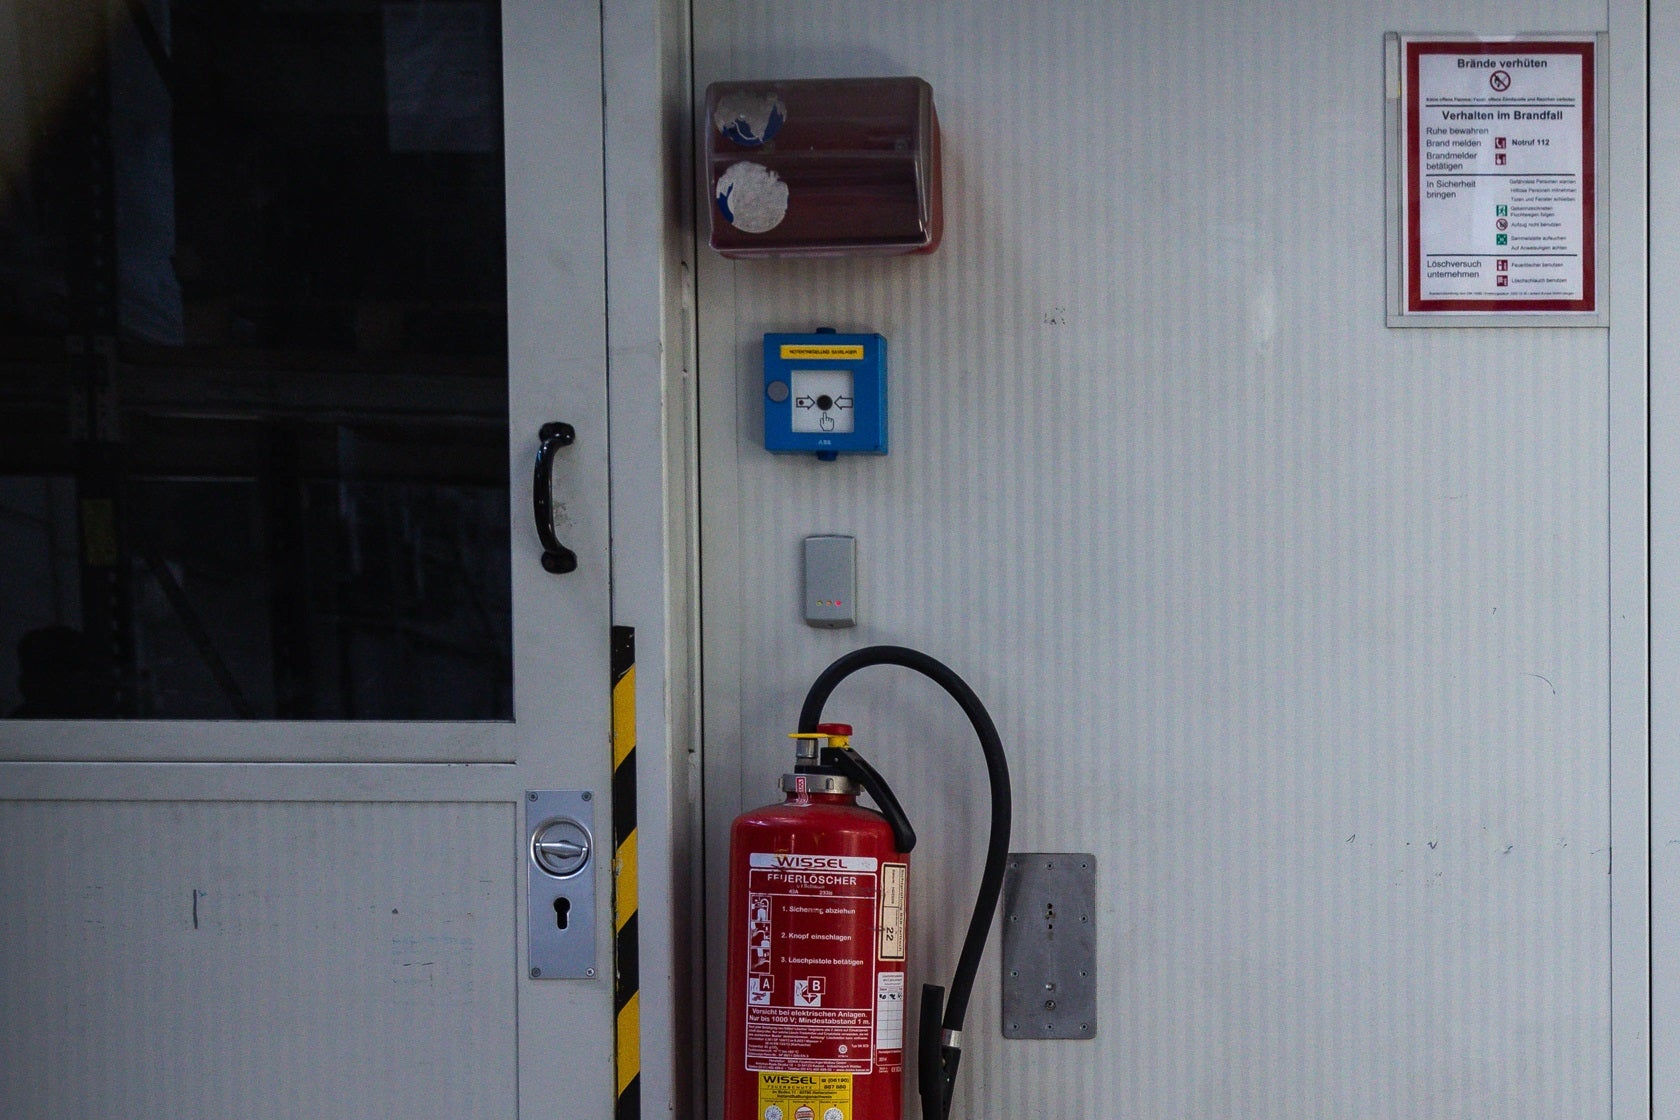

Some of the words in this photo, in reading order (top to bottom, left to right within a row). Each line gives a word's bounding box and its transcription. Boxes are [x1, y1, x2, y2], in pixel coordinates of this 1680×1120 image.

[1457, 58, 1497, 68] Brände
[1499, 58, 1548, 68] verhüten
[1442, 110, 1494, 121] Verhalten
[1497, 110, 1511, 121] im
[1513, 110, 1563, 121] Brandfall
[1426, 127, 1447, 135] Ruhe
[1449, 127, 1489, 135] bewahren
[1426, 139, 1450, 147] Brand
[1452, 139, 1482, 147] melden
[1426, 152, 1477, 160] Brandmelder
[1426, 162, 1463, 172] betätigen
[1426, 180, 1434, 188] In
[1436, 180, 1476, 188] Sicherheit
[1426, 190, 1456, 199] bringen
[1426, 260, 1482, 269] Löschversuch
[777, 857, 848, 869] WISSEL
[788, 932, 809, 940] Knopf
[810, 933, 852, 942] einschlagen
[886, 927, 894, 941] 22
[788, 957, 832, 965] Löschpistole
[833, 958, 864, 966] betätigen
[762, 978, 770, 989] A
[812, 980, 821, 991] B
[790, 1010, 836, 1018] elektrischen
[837, 1011, 868, 1019] Anlagen.
[798, 1017, 856, 1025] Mindestabstand
[763, 1075, 817, 1085] WISSEL
